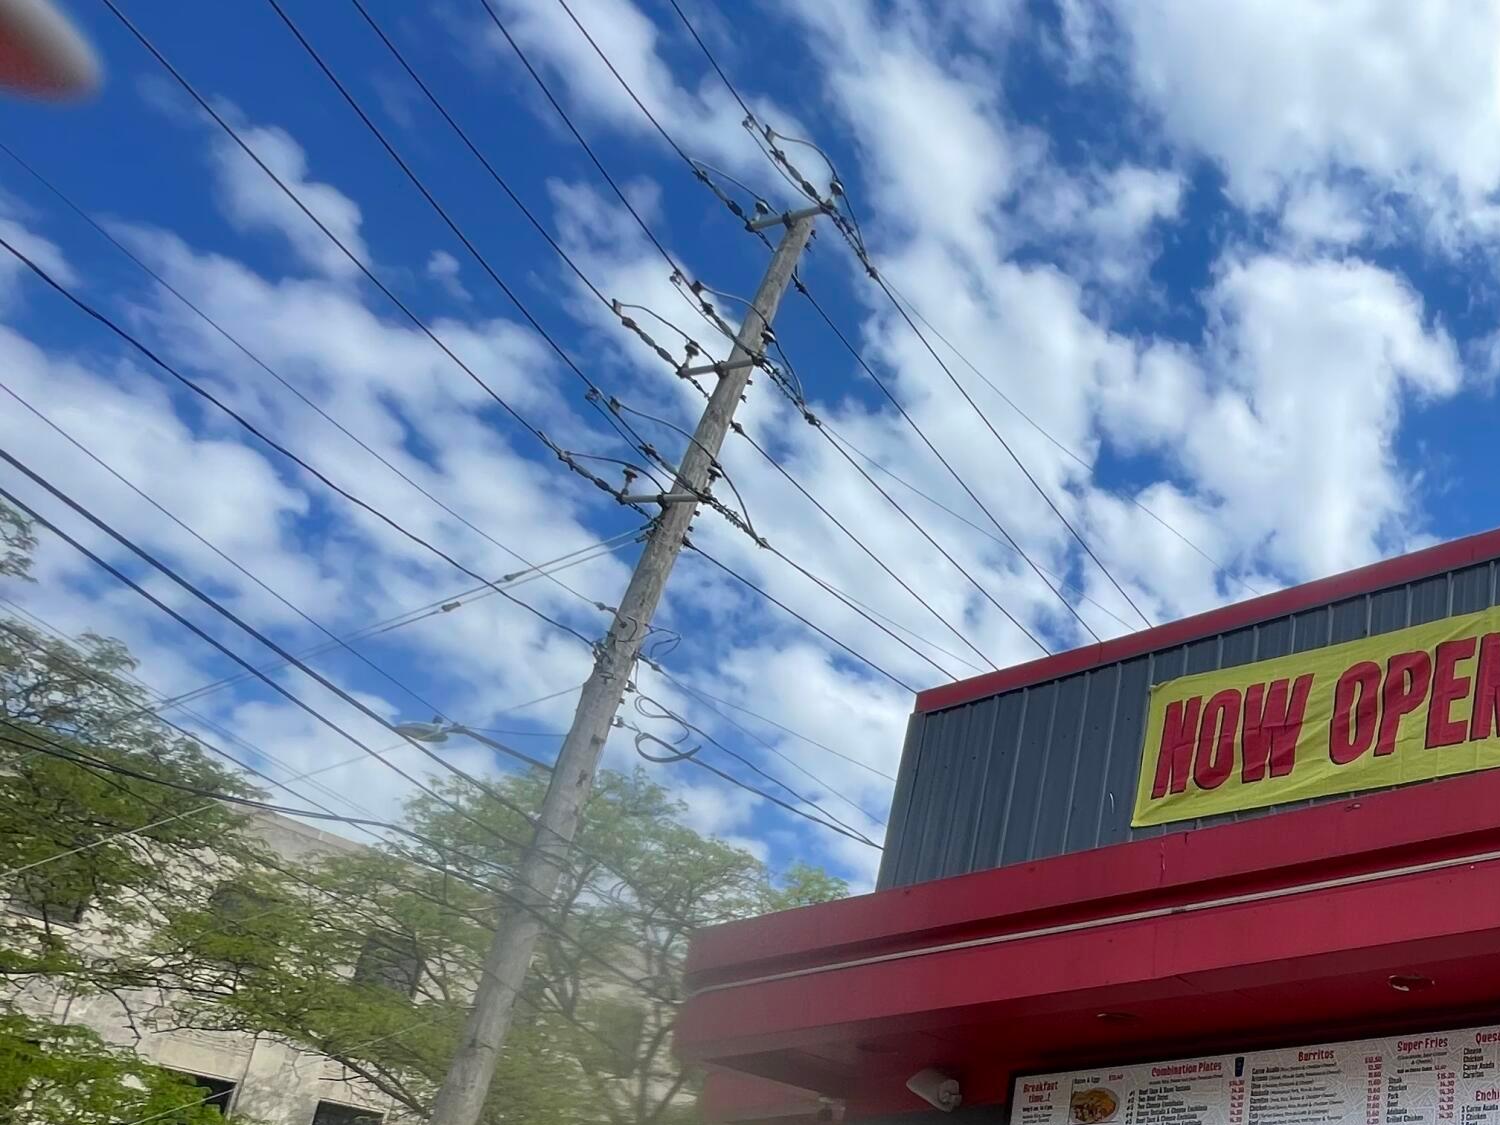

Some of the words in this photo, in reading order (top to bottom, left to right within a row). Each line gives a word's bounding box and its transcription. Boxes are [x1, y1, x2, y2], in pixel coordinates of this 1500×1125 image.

[1151, 673, 1314, 799] NOW
[1397, 1040, 1423, 1053] Super
[1425, 1037, 1448, 1049] Fries
[1298, 1049, 1335, 1062] Burritos
[1152, 1066, 1197, 1077] Combination
[1198, 1062, 1221, 1073] Plates
[1023, 1082, 1058, 1093] Breakfast
[1466, 1113, 1487, 1121] Chicken
